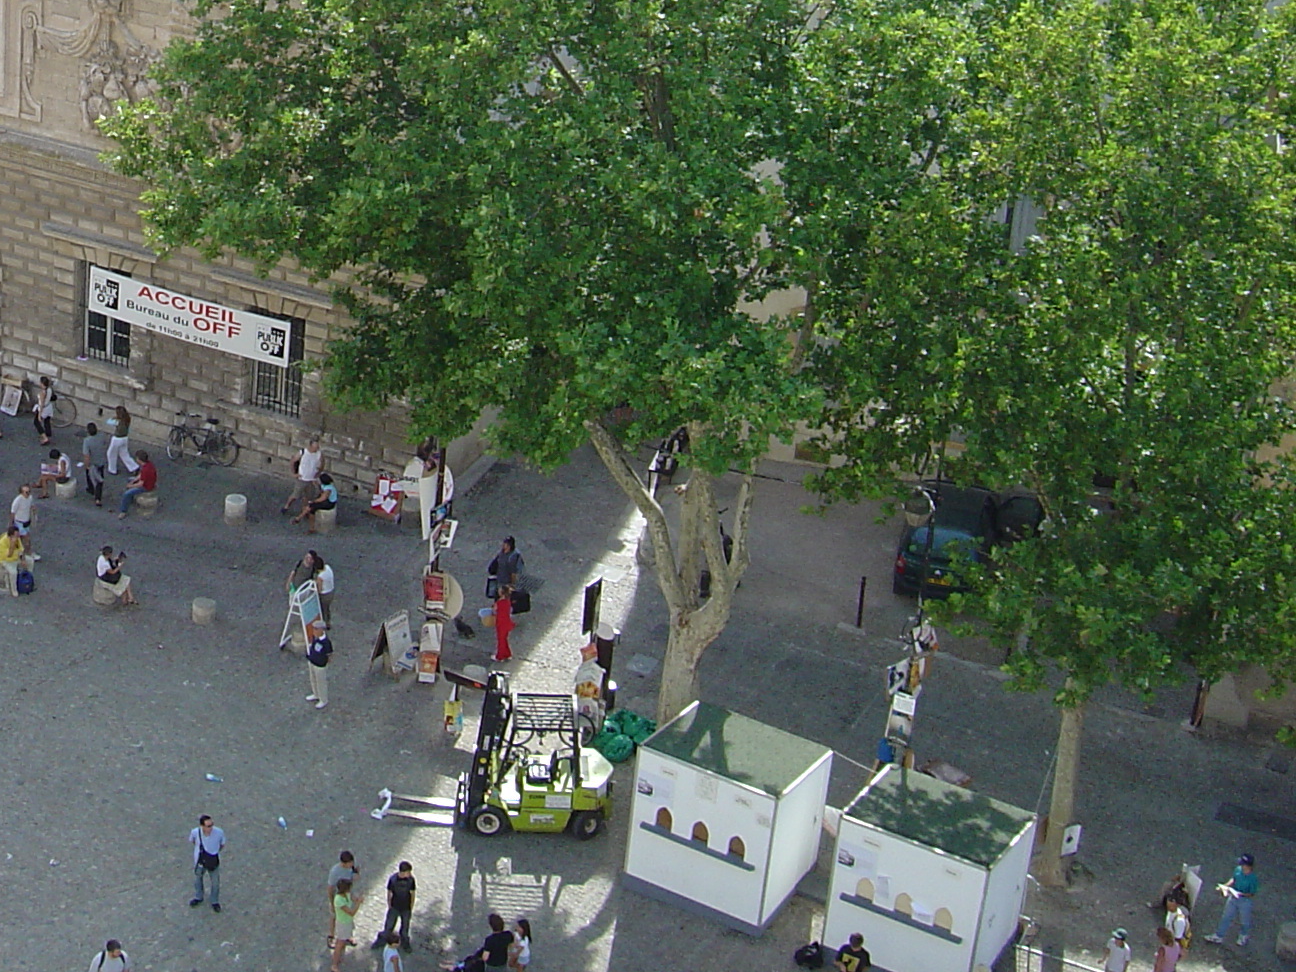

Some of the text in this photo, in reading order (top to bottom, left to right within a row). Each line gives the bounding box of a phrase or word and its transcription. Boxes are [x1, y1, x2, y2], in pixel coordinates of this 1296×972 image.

[126, 299, 242, 338] Bureau du OFF
[138, 286, 242, 326] ACCUEIL
[146, 321, 156, 329] de
[158, 325, 183, 338] 11h00
[192, 335, 220, 348] 21h00
